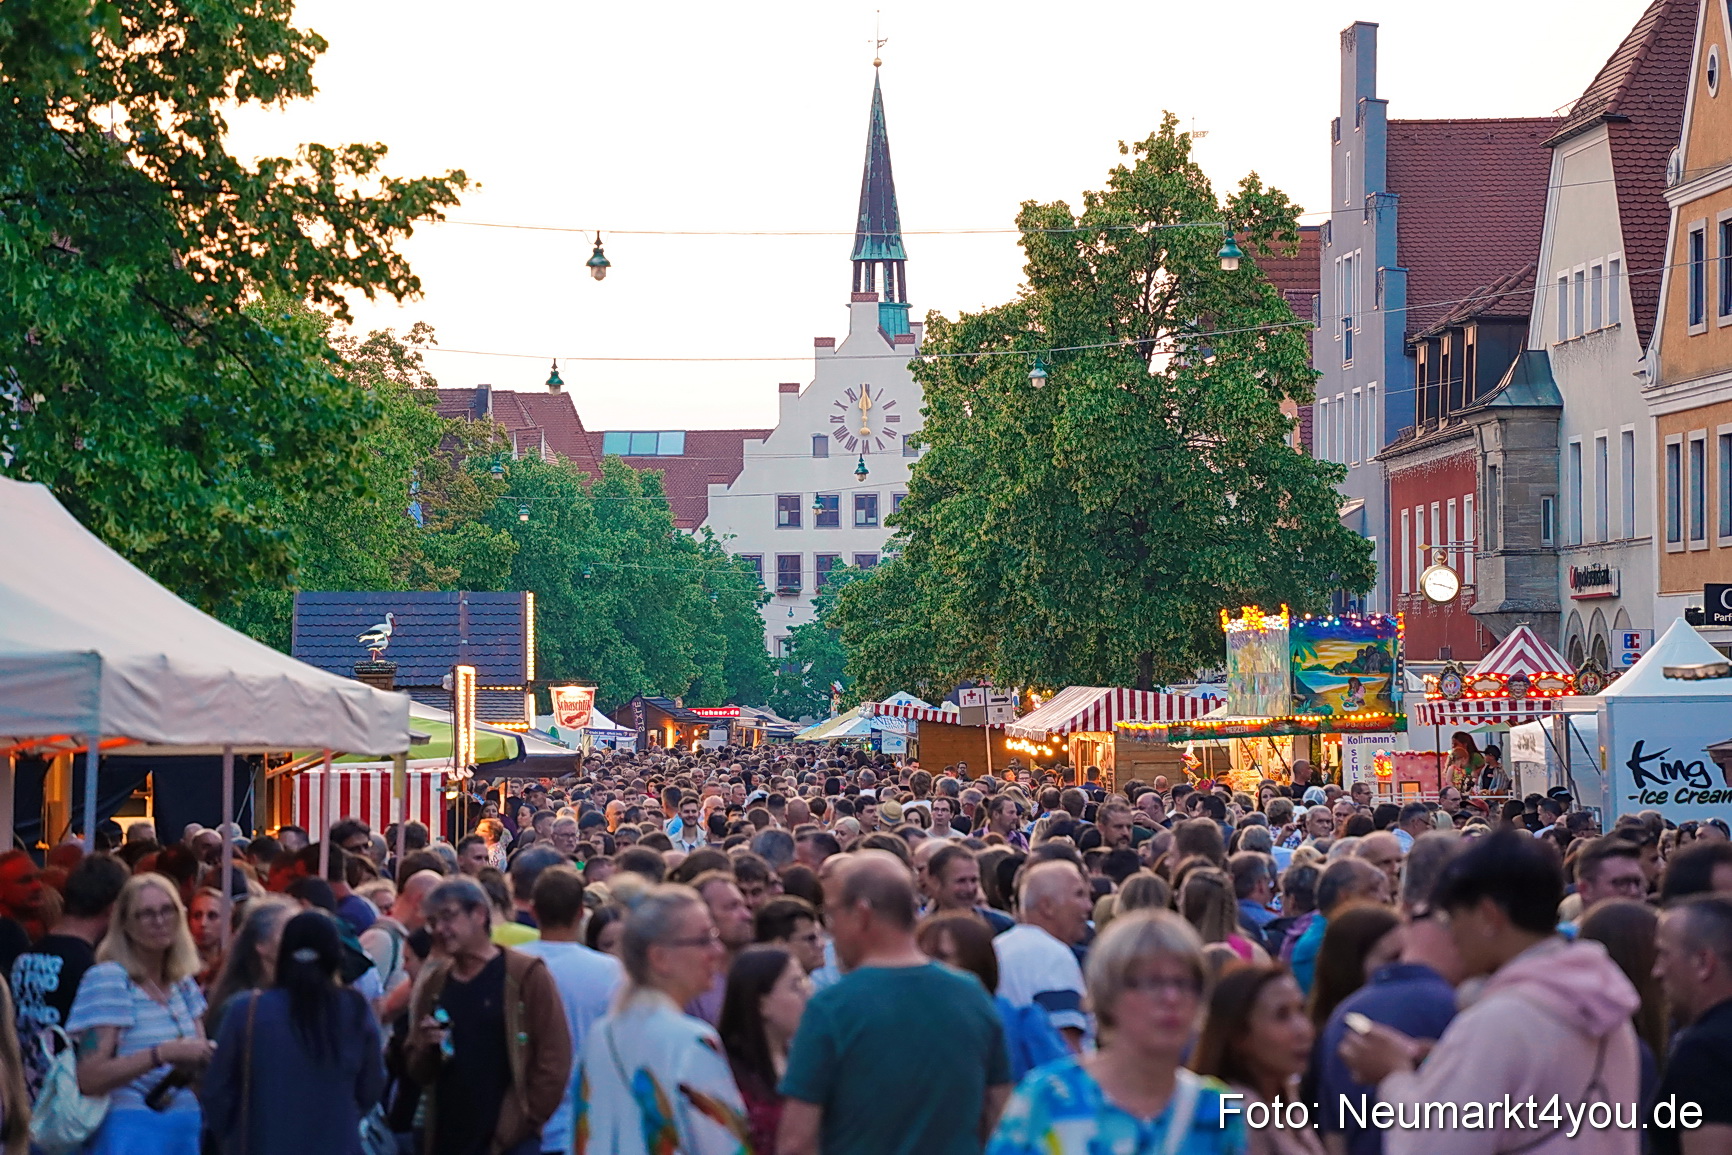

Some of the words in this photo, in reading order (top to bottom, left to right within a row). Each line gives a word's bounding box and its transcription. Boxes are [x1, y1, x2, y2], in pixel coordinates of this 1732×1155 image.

[844, 387, 858, 403] XI
[833, 400, 849, 411] X
[882, 400, 897, 411] II
[885, 415, 900, 423] III
[557, 699, 591, 711] Schaschlik
[1225, 725, 1249, 734] HERZEN
[1347, 735, 1396, 745] Kollmann's
[1626, 740, 1712, 789] King
